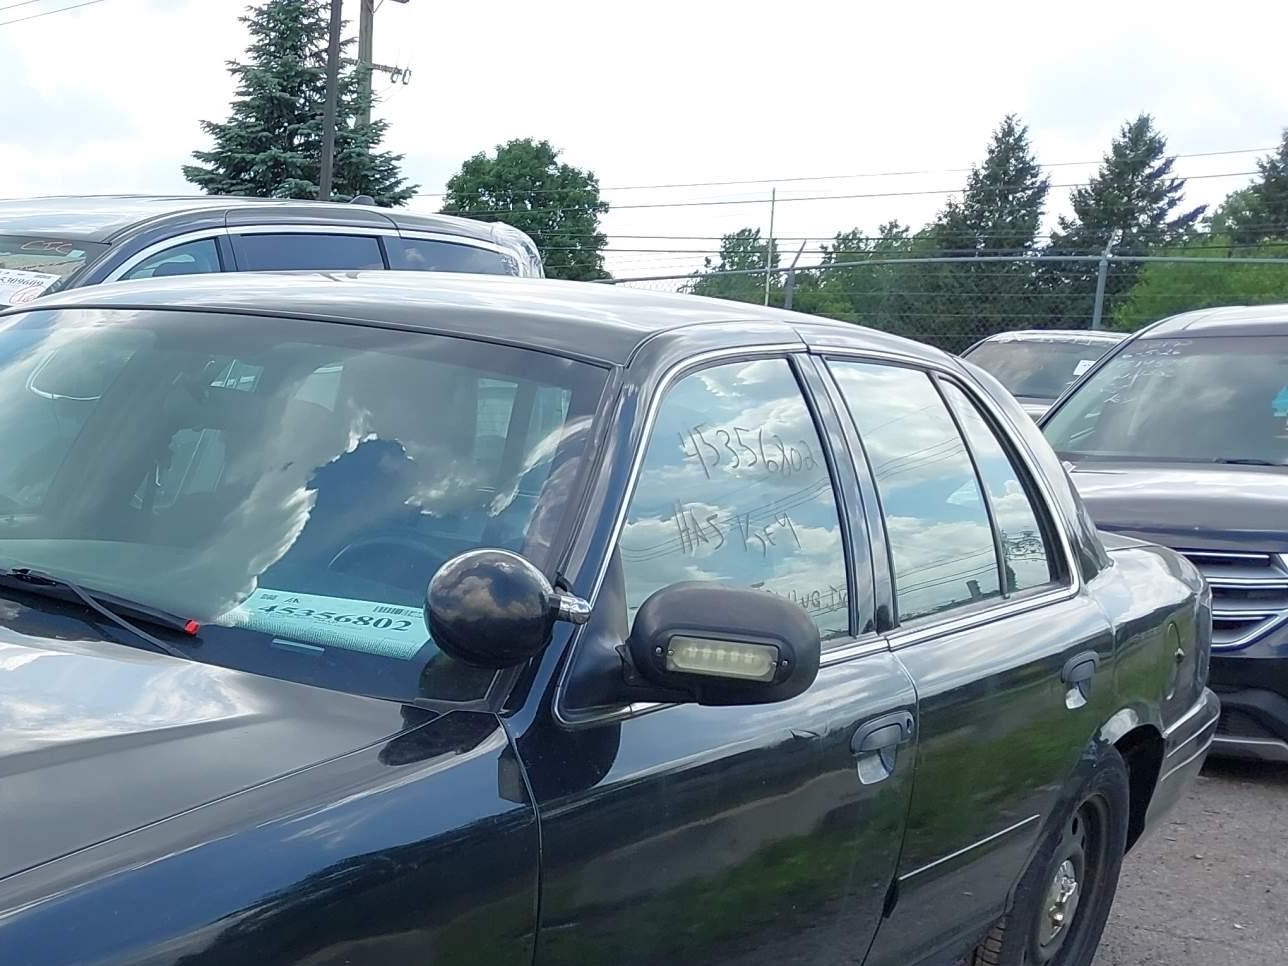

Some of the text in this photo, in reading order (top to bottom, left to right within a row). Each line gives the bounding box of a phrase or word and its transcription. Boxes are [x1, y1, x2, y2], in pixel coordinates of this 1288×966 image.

[677, 422, 819, 480] 45356802
[673, 505, 726, 555] HAS
[258, 604, 413, 632] 45356802
